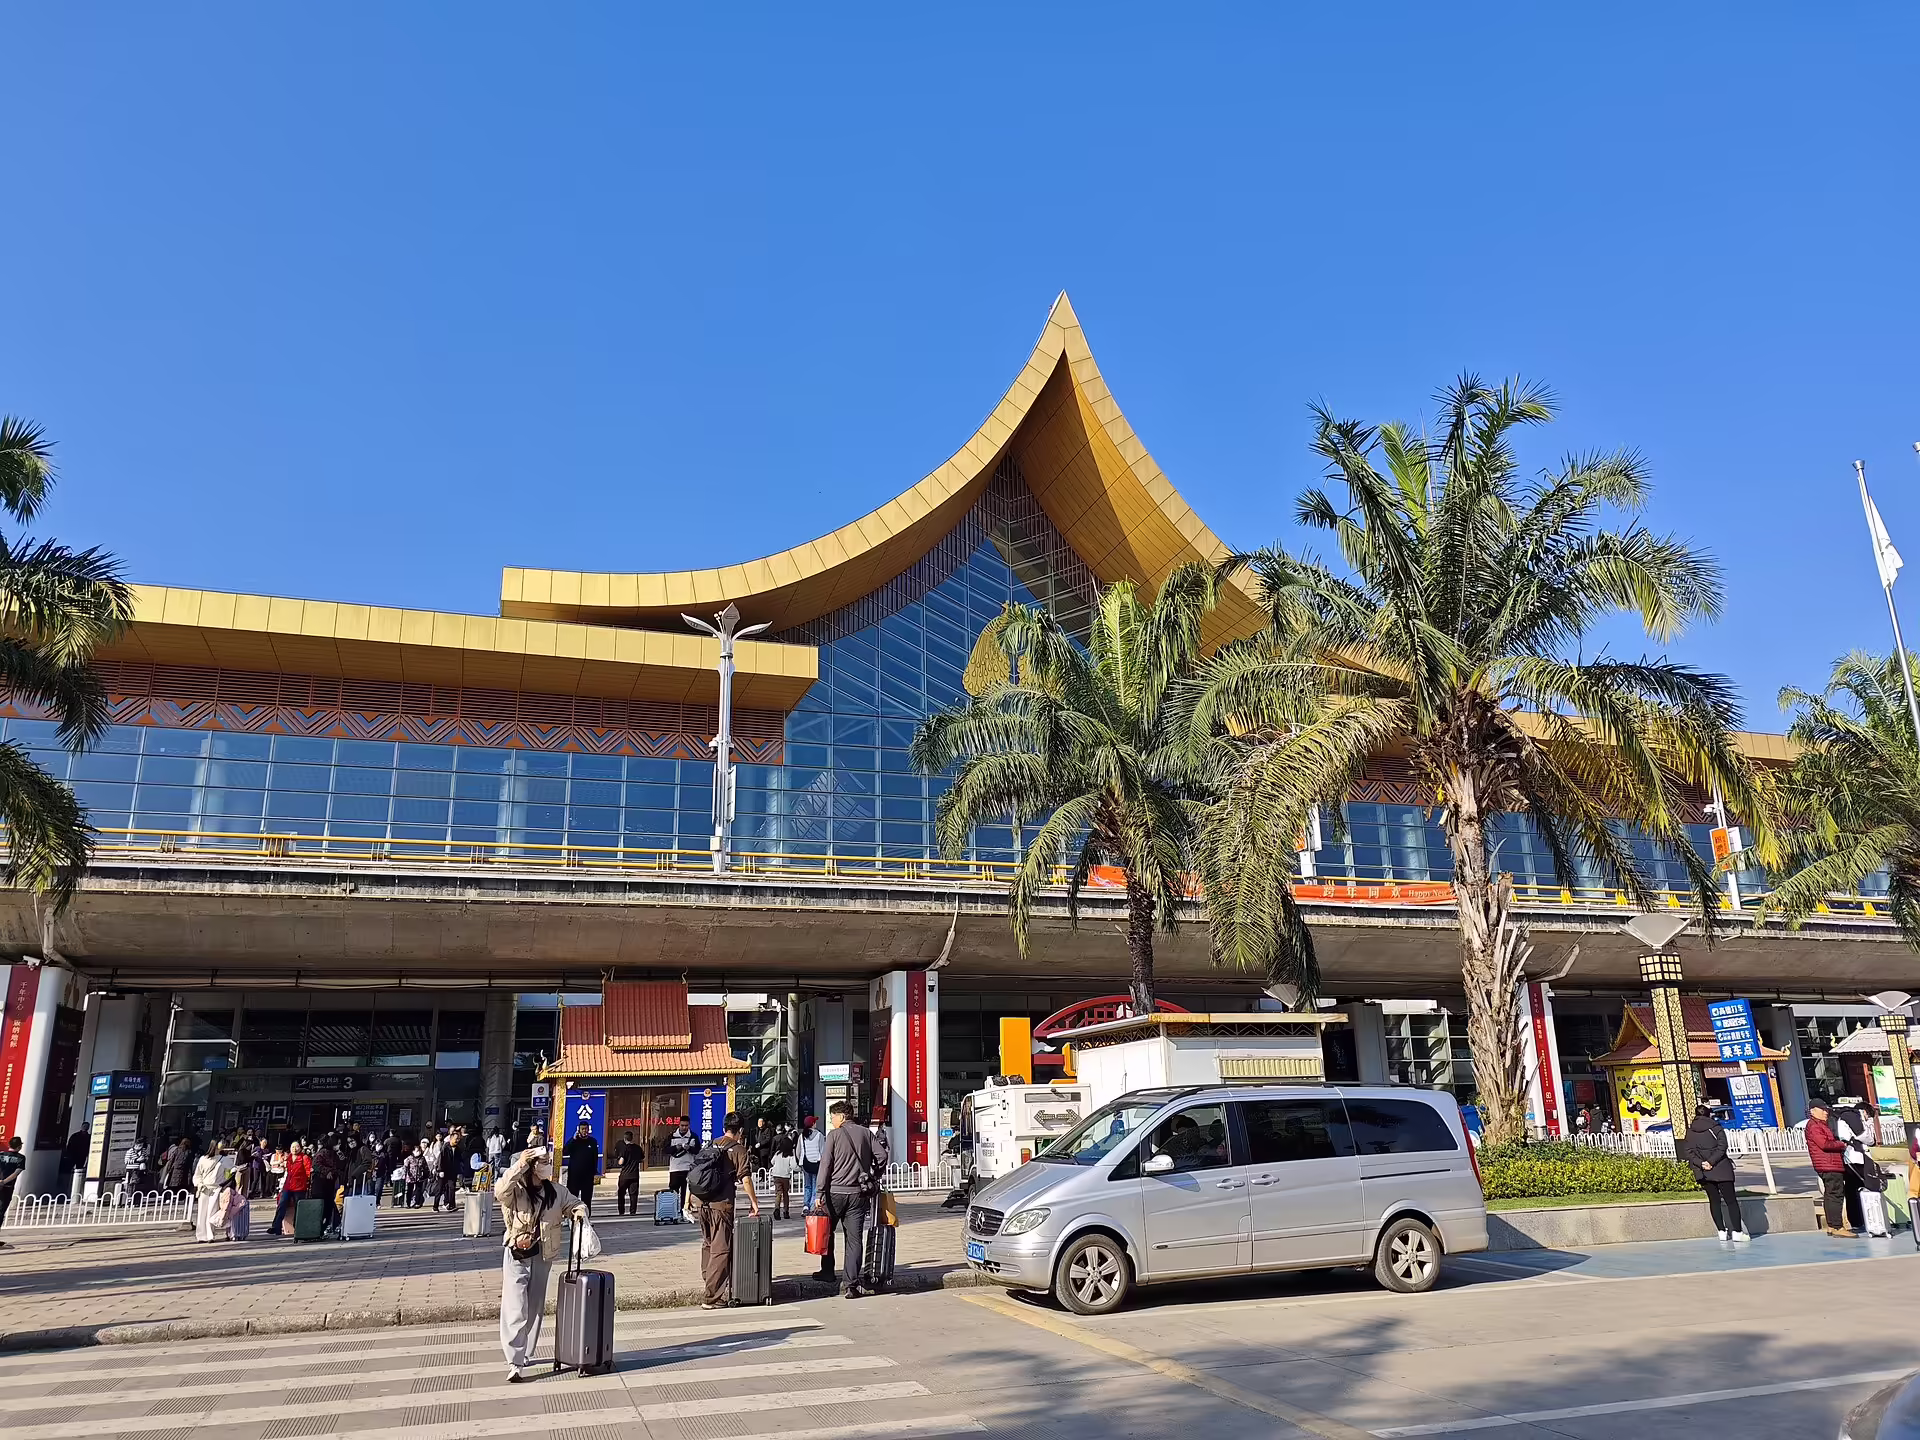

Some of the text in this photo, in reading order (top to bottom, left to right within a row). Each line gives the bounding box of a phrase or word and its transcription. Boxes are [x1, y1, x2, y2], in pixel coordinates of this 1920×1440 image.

[1323, 886, 1402, 899] 跨年同欢
[1408, 889, 1433, 899] Happy
[1722, 1043, 1754, 1058] 乘车点
[343, 1076, 353, 1089] 3
[256, 1105, 288, 1120] 出口
